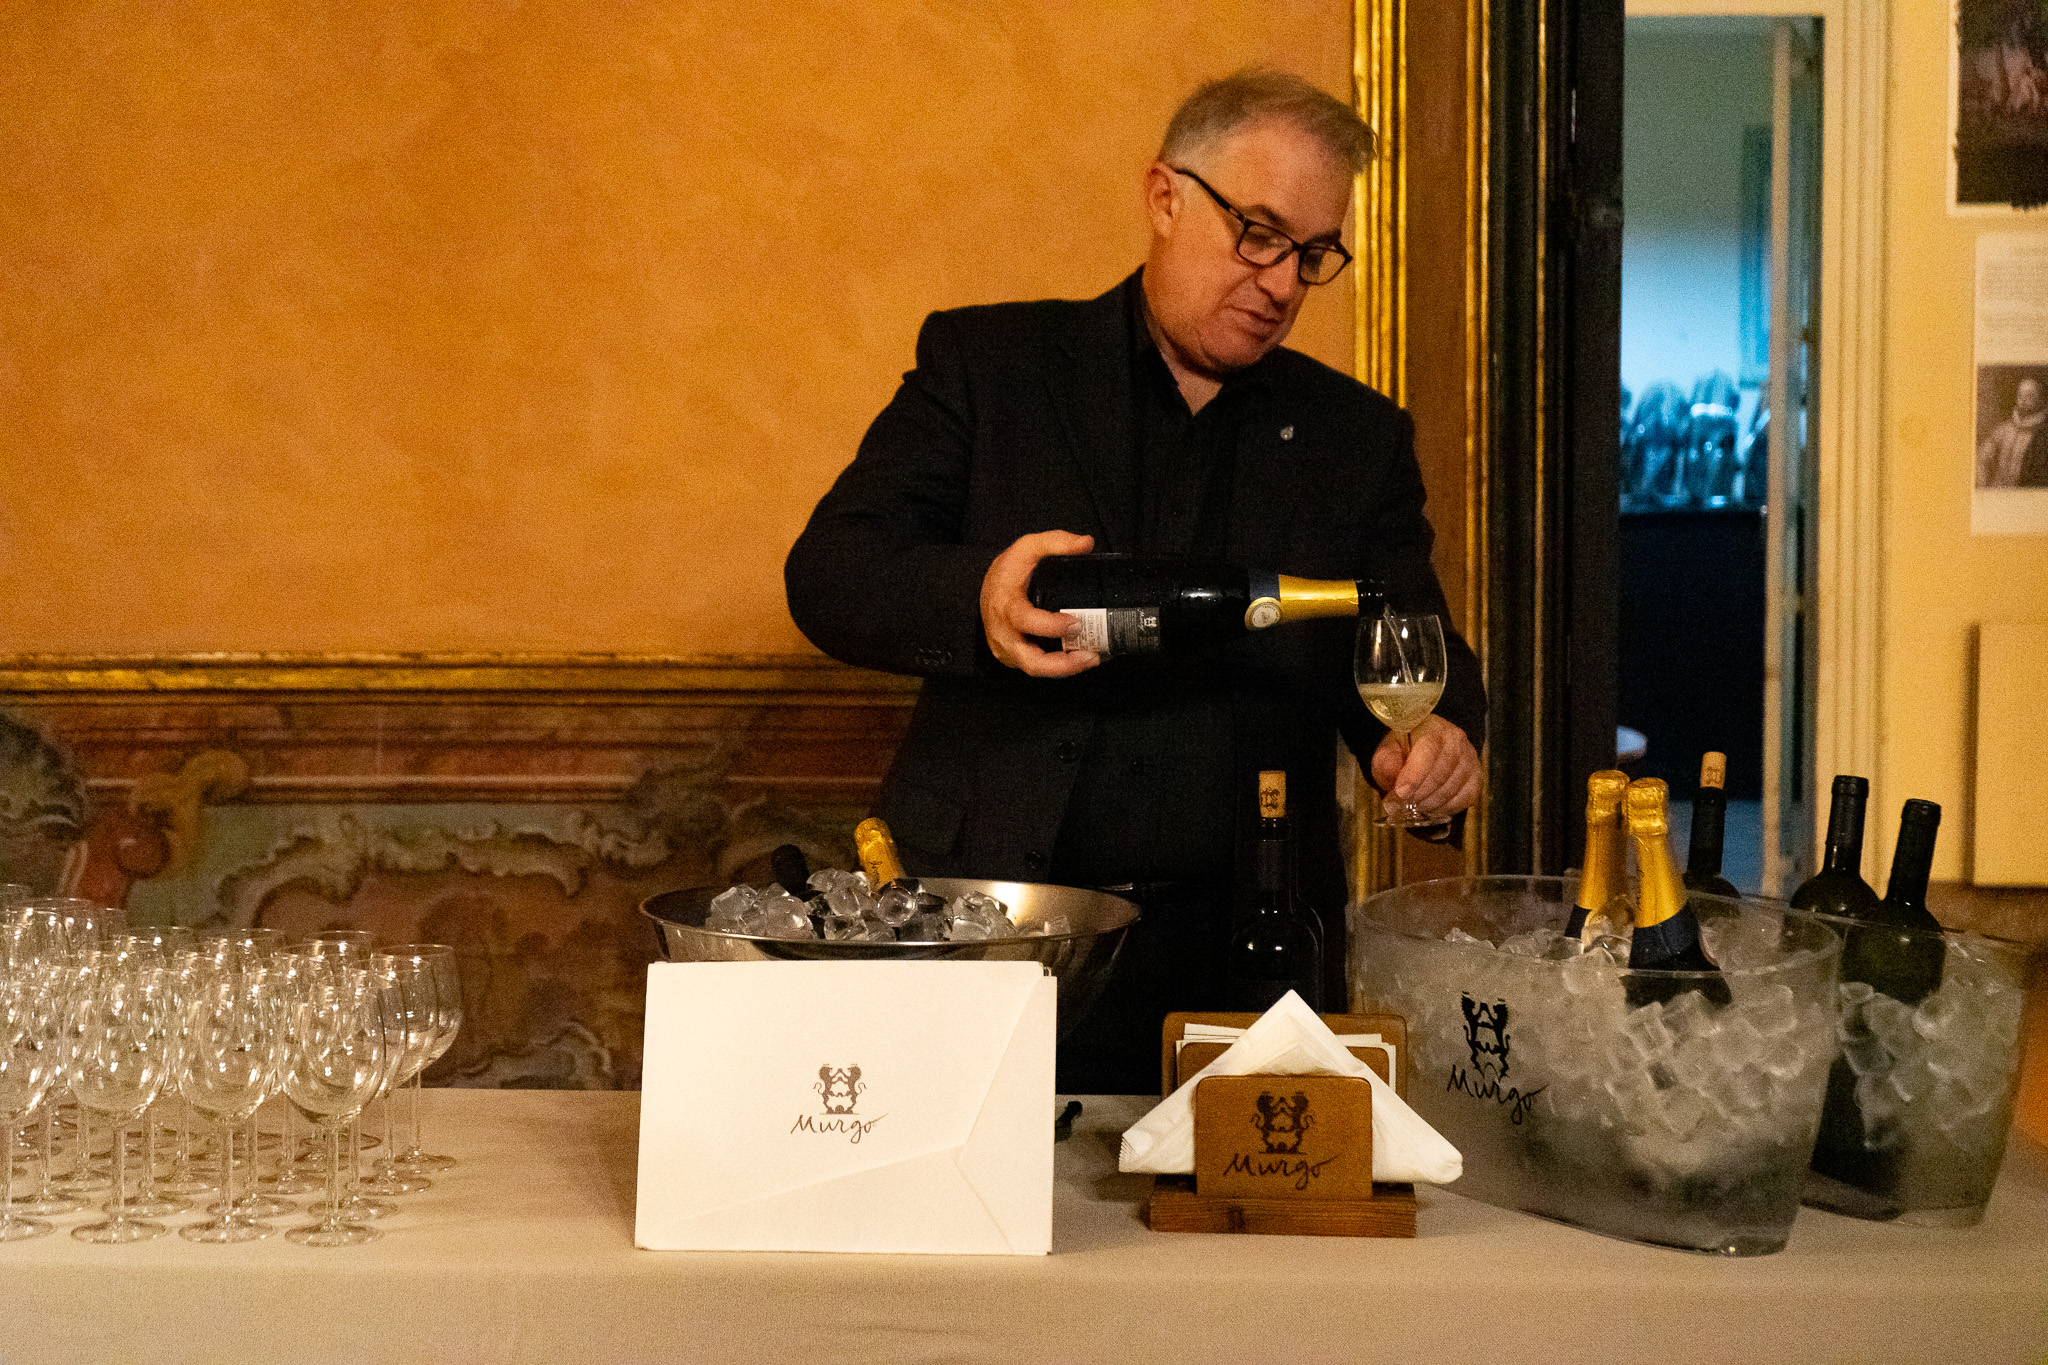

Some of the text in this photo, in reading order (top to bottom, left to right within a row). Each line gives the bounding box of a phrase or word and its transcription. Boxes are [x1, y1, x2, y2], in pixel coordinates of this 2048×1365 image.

[1446, 1064, 1550, 1126] Murgo
[790, 1113, 889, 1144] Murgo
[1223, 1153, 1343, 1191] Murgo
